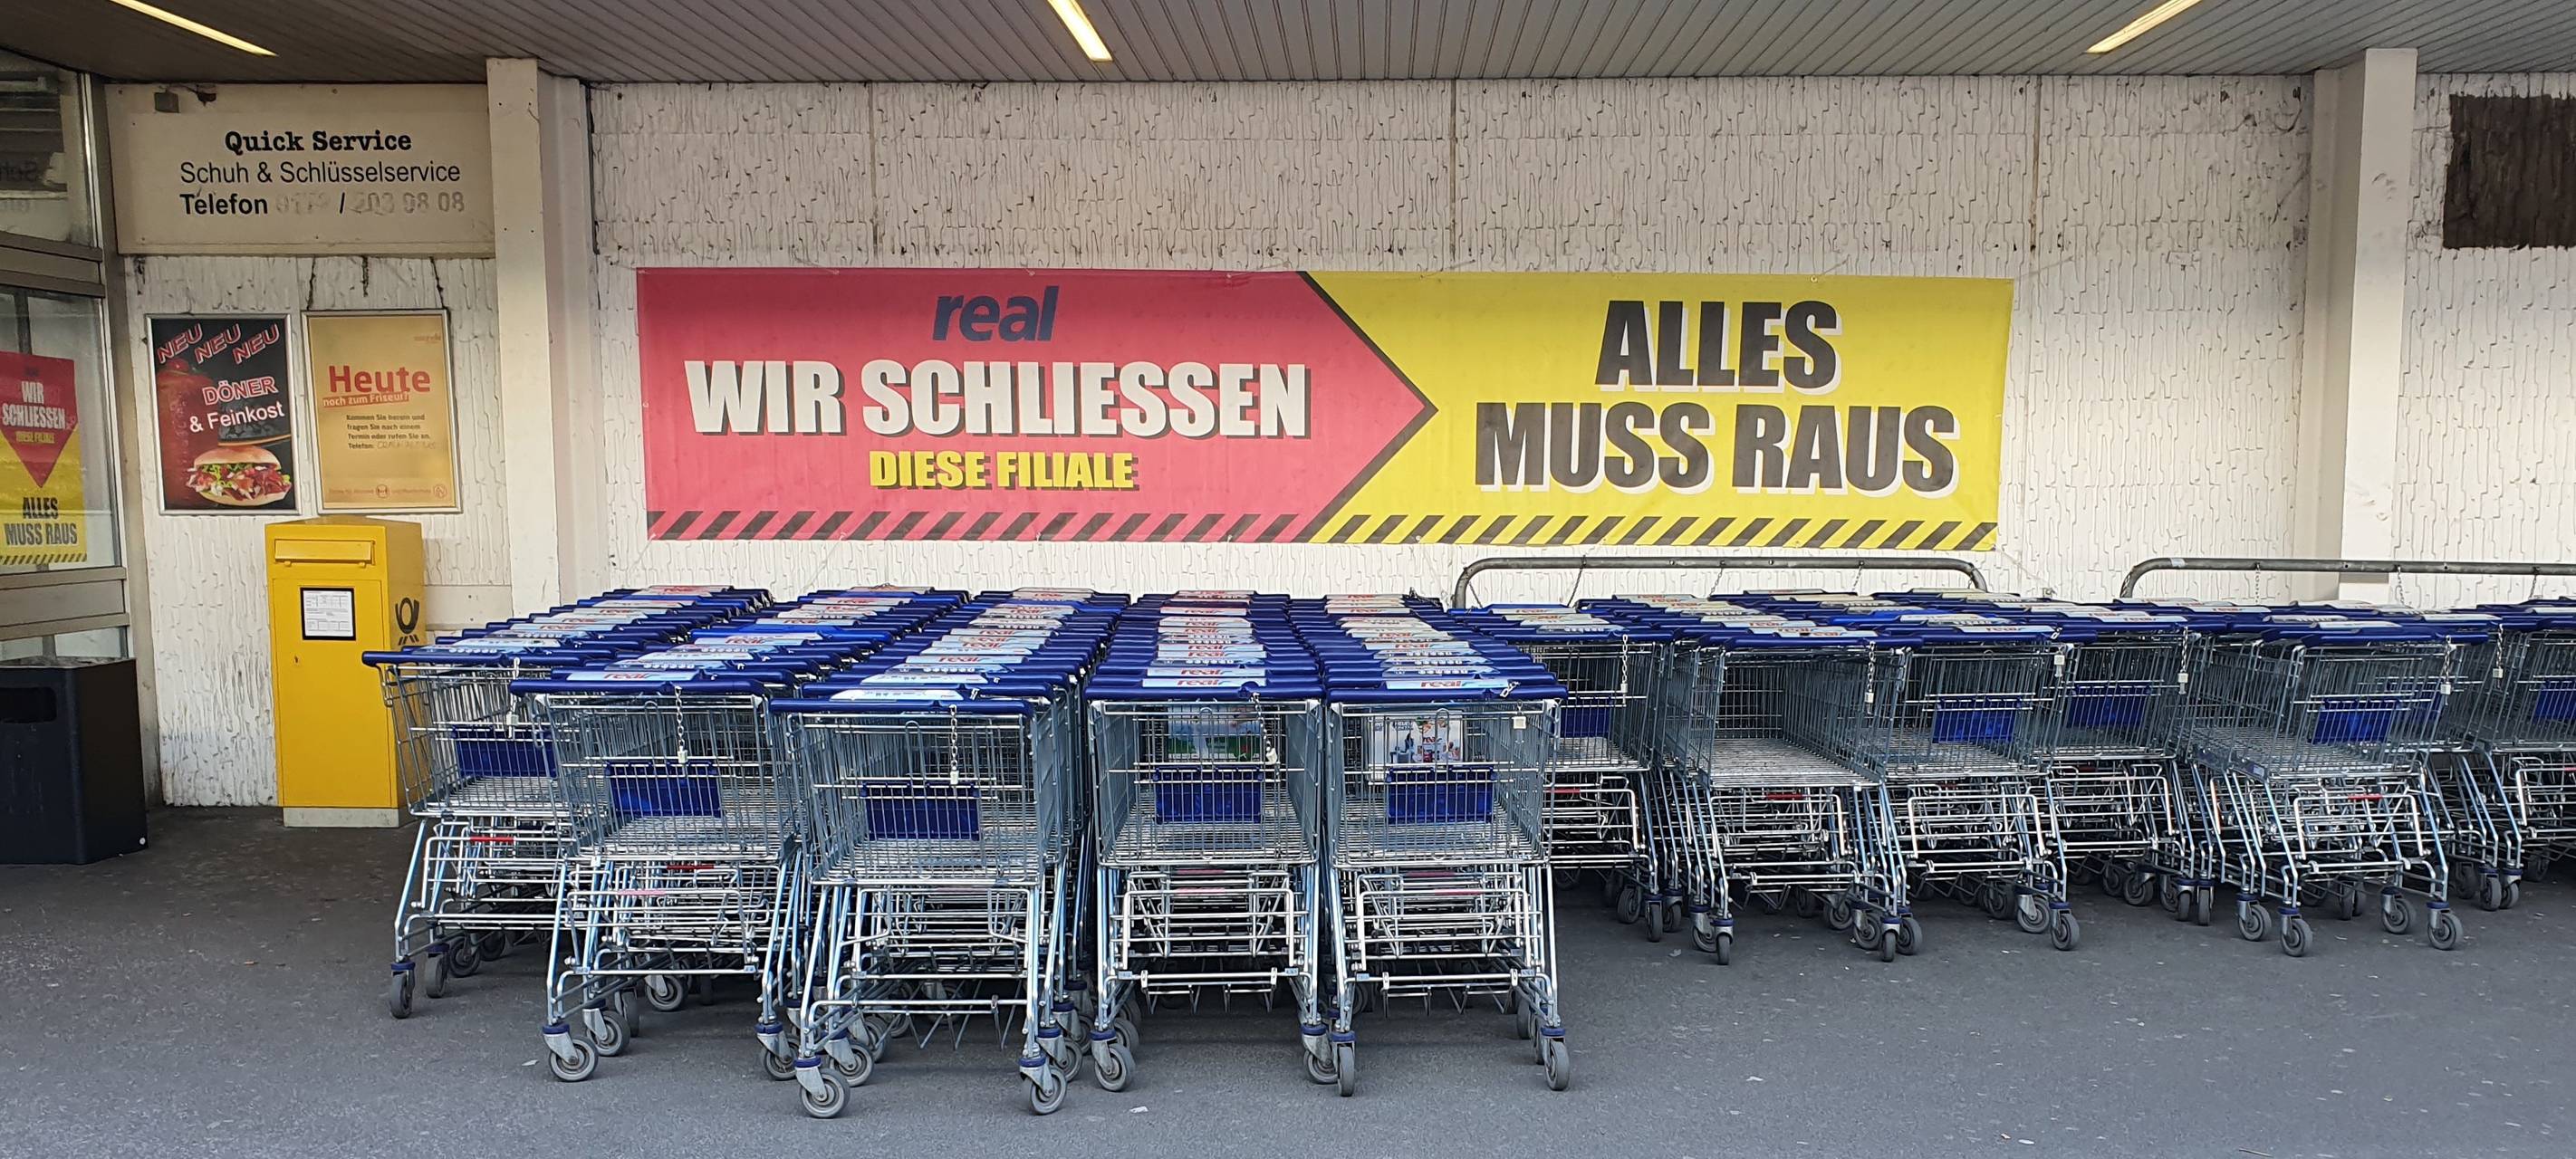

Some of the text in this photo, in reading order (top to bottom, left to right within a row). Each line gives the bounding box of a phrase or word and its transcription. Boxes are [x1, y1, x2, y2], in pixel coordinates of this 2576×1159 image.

[226, 129, 412, 156] Quick Service
[180, 159, 460, 183] Schuh & Schlüsselservice
[180, 192, 268, 215] Telefon
[339, 192, 345, 214] /
[931, 285, 1059, 341] real
[157, 323, 203, 364] NEU
[195, 323, 242, 364] NEU
[232, 323, 280, 364] NEU
[1594, 300, 1841, 389] ALLES
[21, 380, 44, 404] WIR
[202, 376, 278, 406] DÖNER
[329, 365, 430, 393] Heute
[323, 397, 346, 407] noch
[348, 395, 368, 405] zum
[684, 359, 1309, 438] WIR SCHLIESSEN
[2, 402, 66, 430] SCHLIESSEN
[189, 400, 285, 433] & Feinkost
[347, 423, 369, 432] fragen
[1475, 401, 1957, 493] MUSS RAUS
[869, 450, 1137, 491] DIESE FILIALE
[23, 497, 59, 519] ALLES
[5, 522, 78, 546] MUSS RAUS
